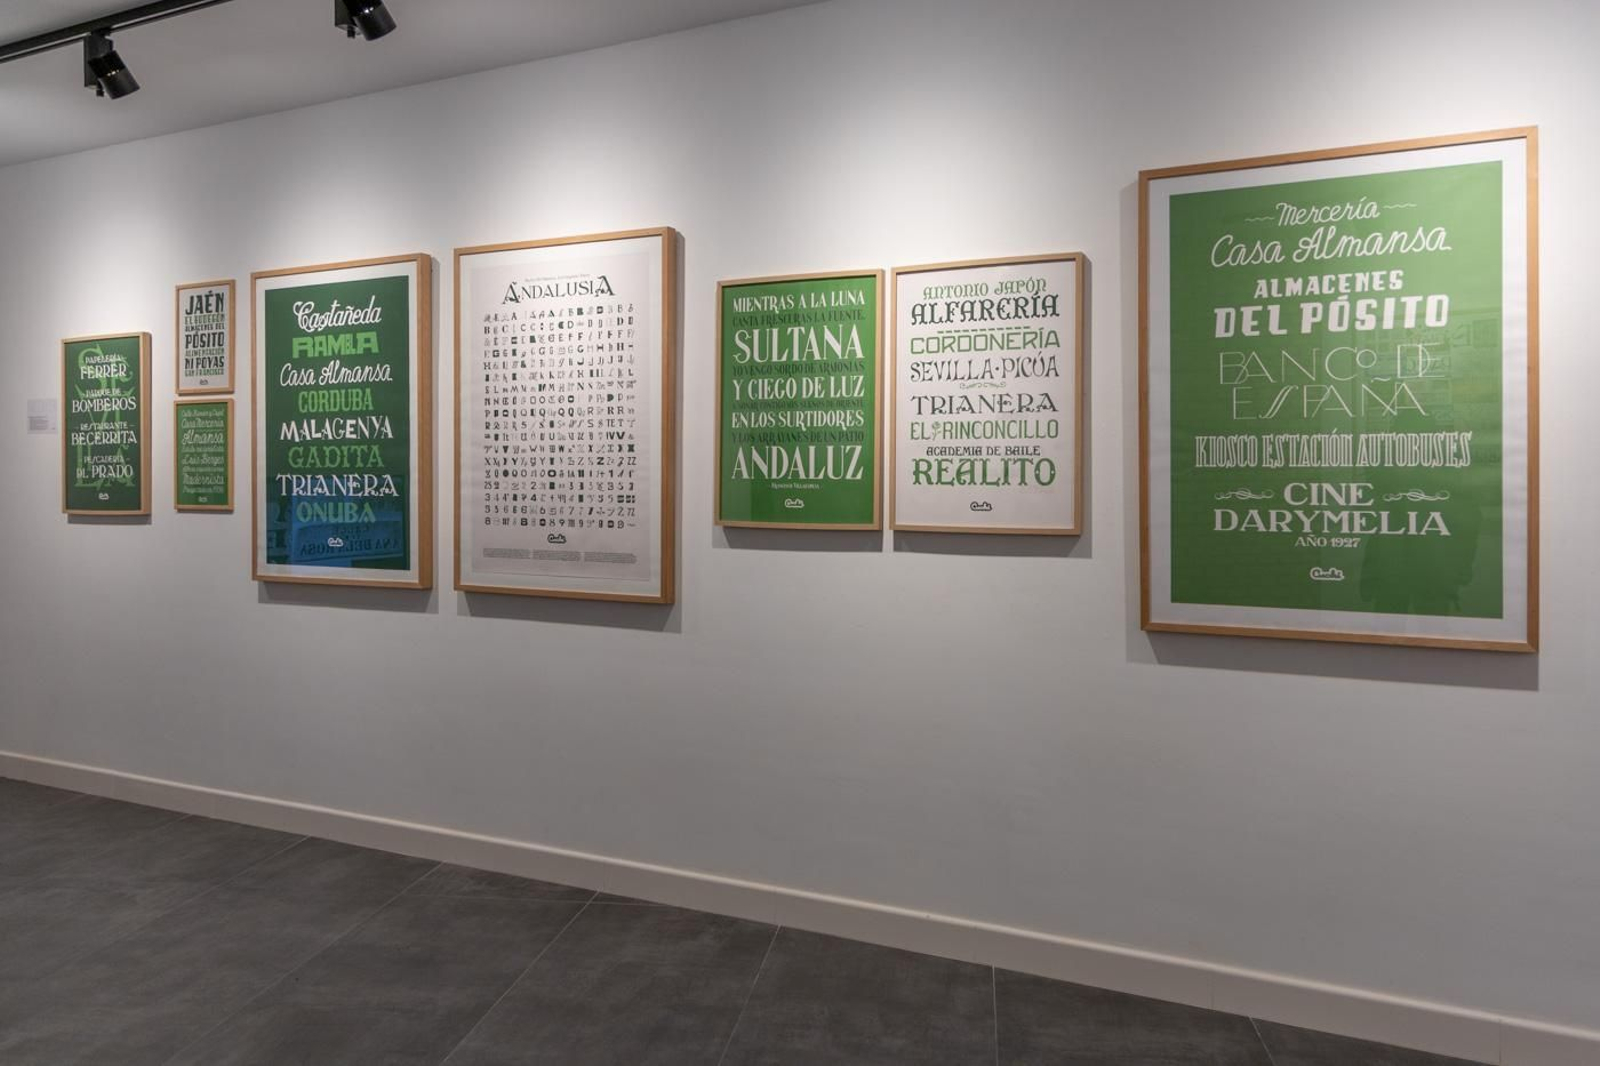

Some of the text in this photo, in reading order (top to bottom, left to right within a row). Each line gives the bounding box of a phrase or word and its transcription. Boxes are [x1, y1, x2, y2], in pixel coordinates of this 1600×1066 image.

[1275, 196, 1380, 227] Mercería
[1211, 226, 1452, 268] Casa Almansa
[923, 276, 1047, 300] ANTONIO JAPÓN
[1253, 269, 1404, 299] ALMACENES
[185, 290, 225, 315] JAÉN
[293, 295, 382, 333] Castañeda
[733, 289, 865, 314] MIENTRAS A LA LUNA
[911, 291, 1060, 326] ALFARERÍA
[1214, 294, 1449, 338] DEL PÓSITO
[185, 331, 225, 349] PÓSITO
[292, 331, 379, 359] RAMBLA
[733, 323, 865, 364] SULTANA
[910, 327, 1061, 355] CORDONERÍA
[81, 363, 127, 380] FERRER
[280, 360, 393, 386] Casa Almansa
[1219, 342, 1445, 385] BANCO DE
[298, 388, 374, 413] CORDUBA
[733, 375, 865, 401] Y CIEGO DE LUZ
[1233, 377, 1429, 420] ESPAÑA
[72, 396, 137, 413] BOMBEROS
[910, 393, 1059, 415] TRIANERA
[280, 415, 393, 442] MALAGENYA
[731, 410, 865, 432] EN LOS SURTIDORES
[910, 419, 1059, 440] EL RINCONCILLO
[71, 430, 137, 446] BECERRITA
[926, 445, 1041, 456] ACADEMIA DE BAILE
[1194, 428, 1473, 469] KIOSCO ESTACIÓN AUTOBUSES
[288, 444, 384, 468] GADITA
[731, 445, 864, 480] ANDALUZ
[91, 464, 134, 479] PRADO
[912, 458, 1056, 487] REALITO
[276, 473, 399, 497] TRIANERA
[1283, 482, 1374, 506] CINE
[297, 501, 376, 523] ONUBA
[1214, 508, 1451, 536] DARYMELIA
[1294, 534, 1361, 548] AÑO 1927
